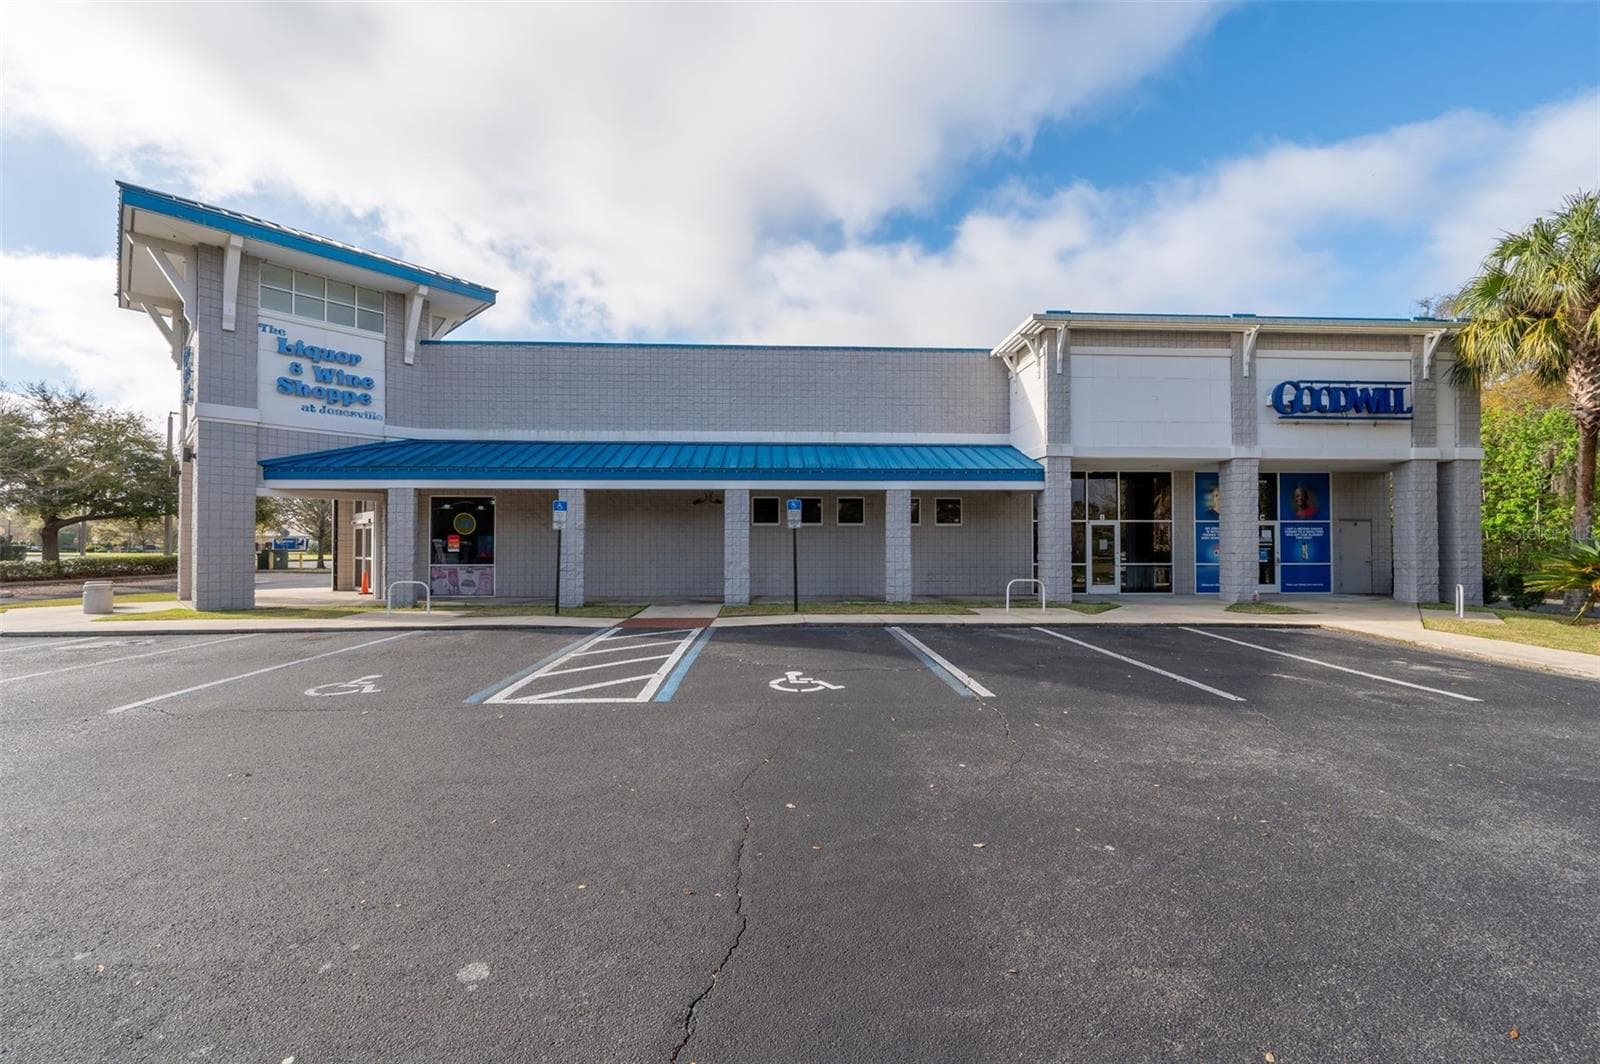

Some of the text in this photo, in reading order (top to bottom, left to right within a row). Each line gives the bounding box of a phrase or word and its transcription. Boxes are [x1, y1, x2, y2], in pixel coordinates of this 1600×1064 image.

[258, 322, 287, 336] The
[277, 336, 362, 366] Liquor
[312, 364, 375, 390] Wine
[277, 376, 372, 407] Shoppe
[301, 404, 316, 413] at
